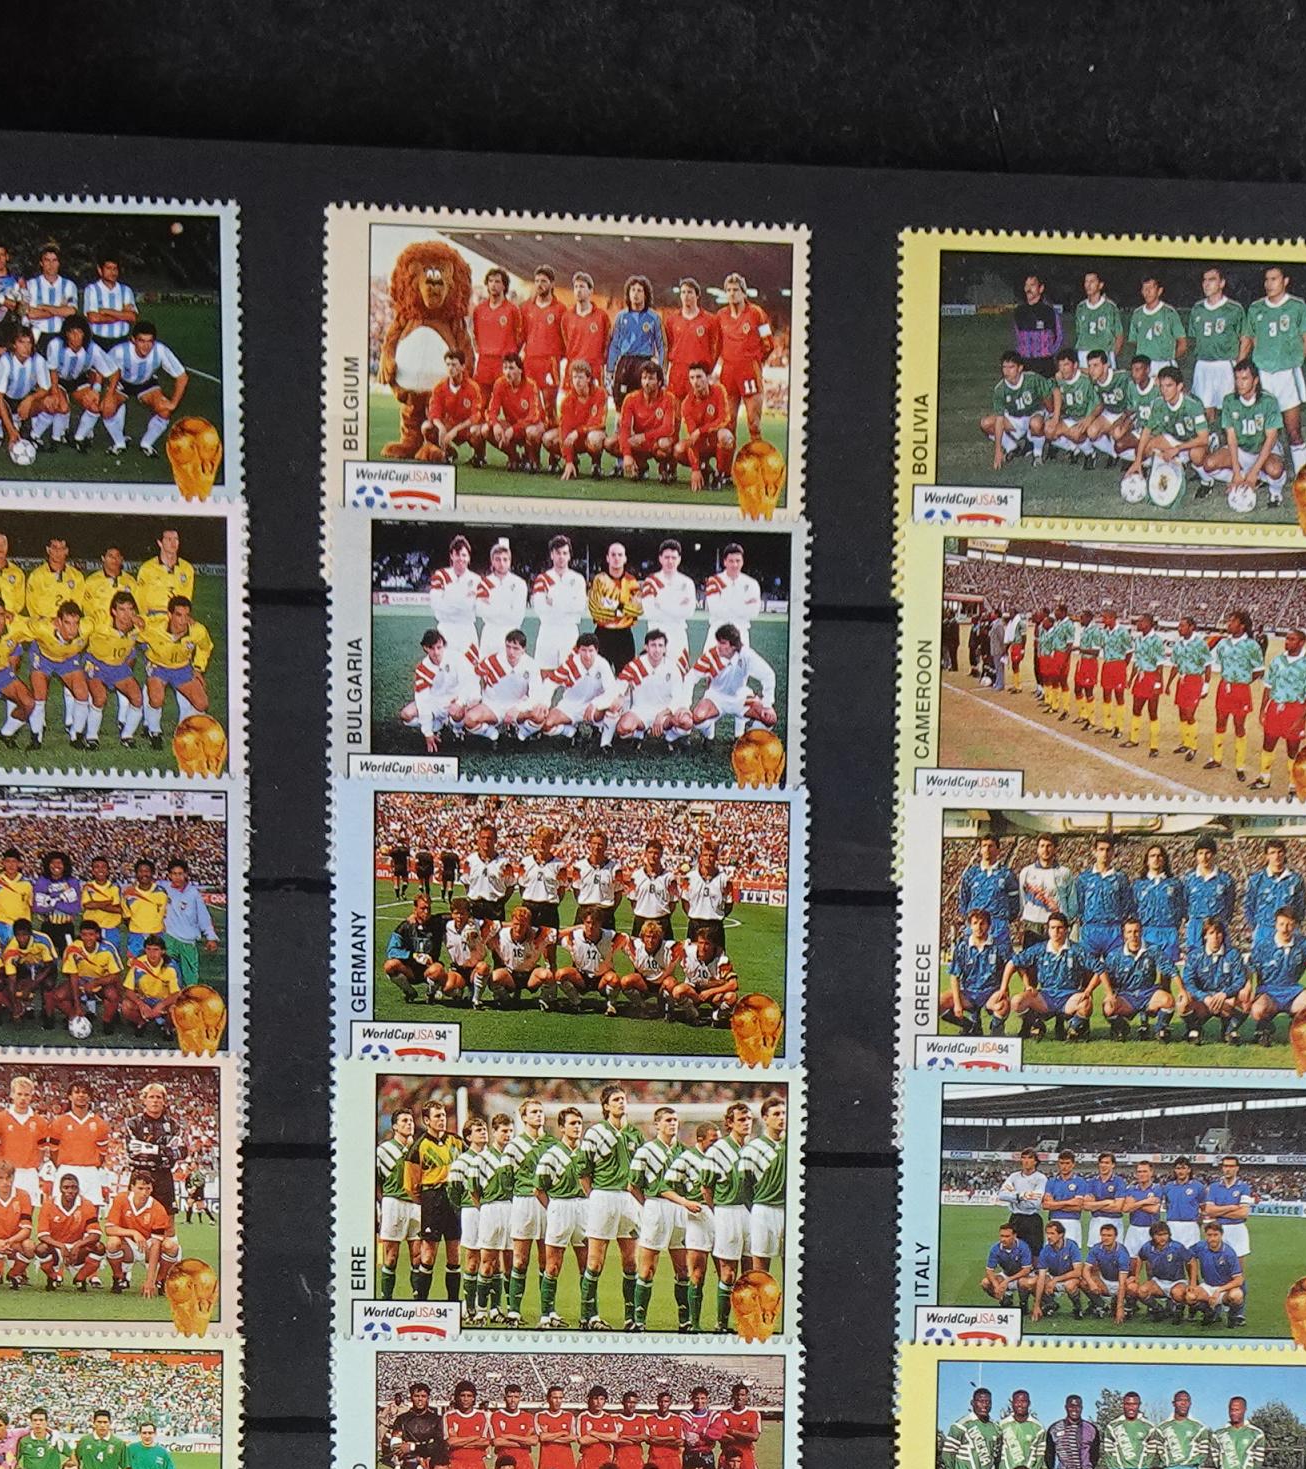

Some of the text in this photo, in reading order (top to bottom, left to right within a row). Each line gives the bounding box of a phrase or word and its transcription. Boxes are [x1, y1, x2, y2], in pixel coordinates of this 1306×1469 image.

[342, 356, 360, 452] BELGIUM
[911, 393, 929, 476] BOLIVIA
[346, 638, 363, 745] BULGARIA
[913, 640, 933, 760] CAMEROON
[350, 911, 367, 1013] GERMANY
[914, 944, 931, 1027] GREECE
[350, 1246, 367, 1291] EIRE
[914, 1242, 930, 1298] ITALY
[37, 1447, 44, 1457] 3
[96, 1452, 104, 1462] 4
